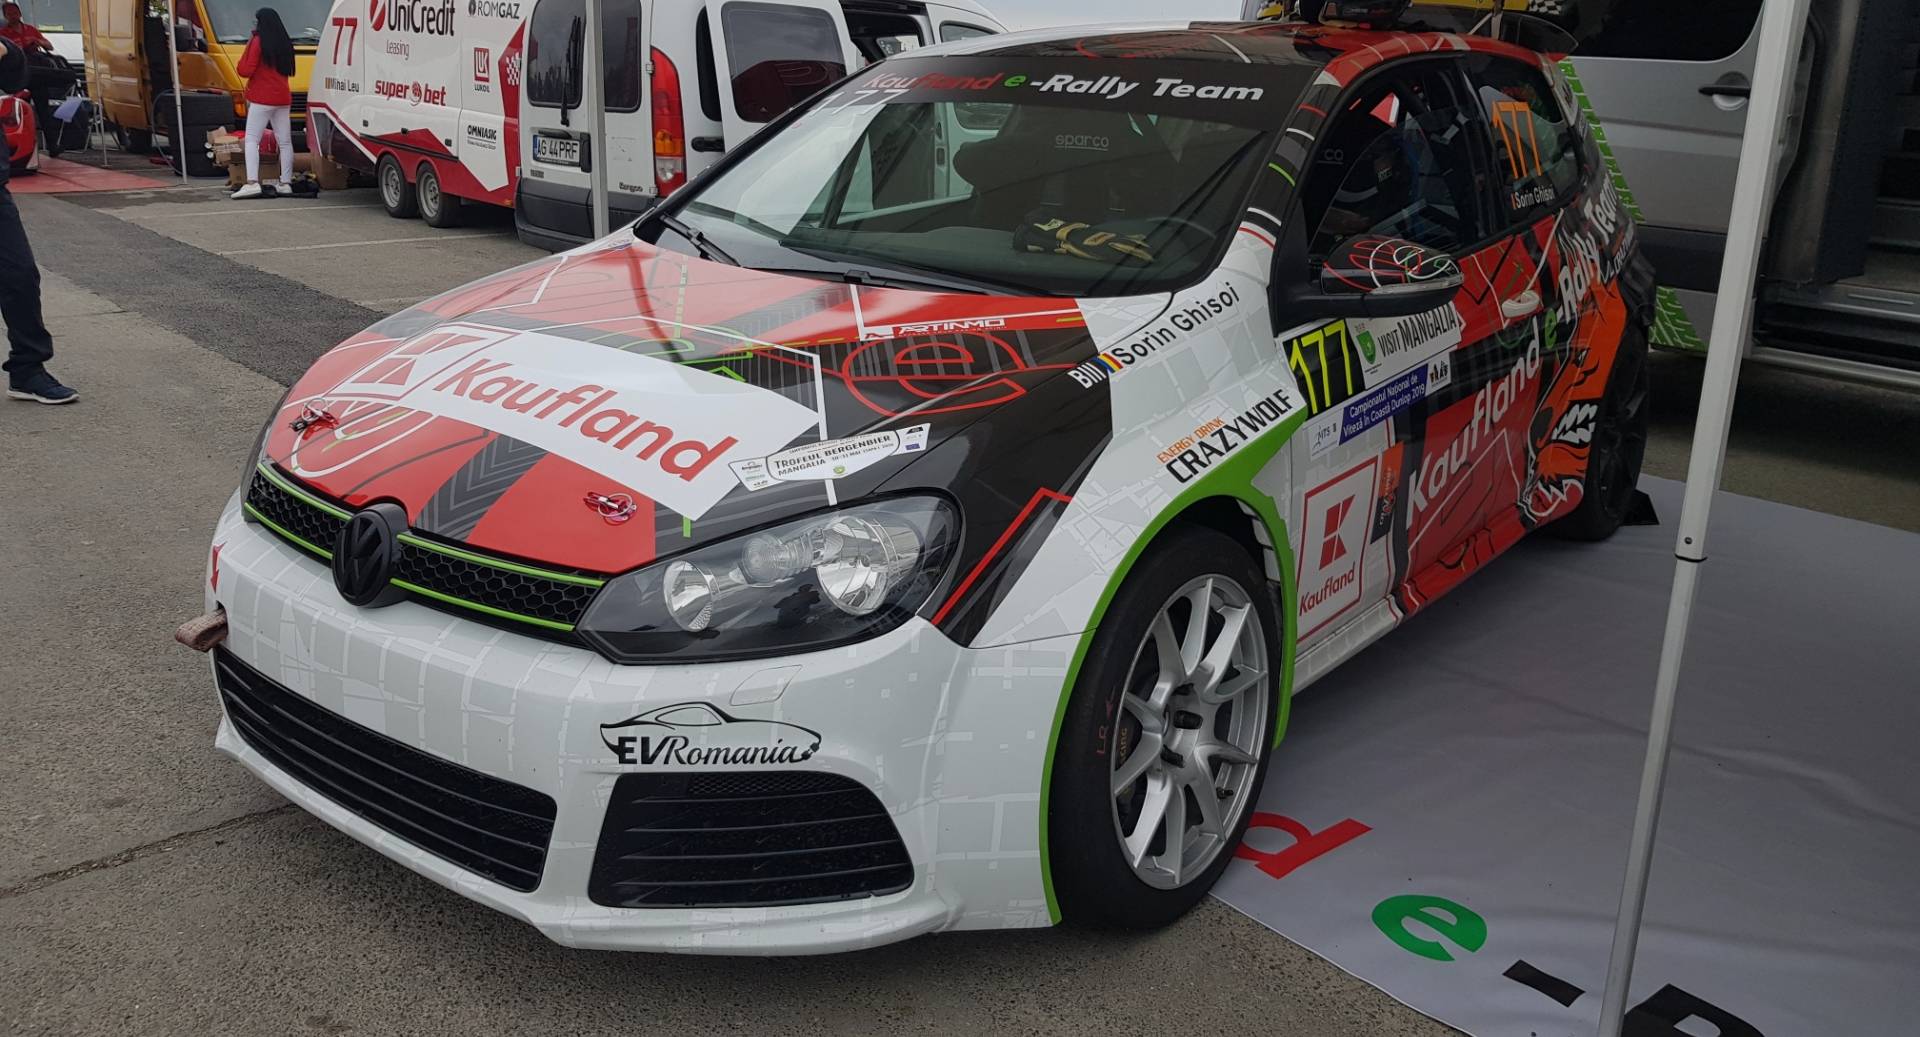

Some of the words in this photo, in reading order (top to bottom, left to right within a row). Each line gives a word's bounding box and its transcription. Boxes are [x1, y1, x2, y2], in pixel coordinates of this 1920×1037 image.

[388, 0, 455, 36] UniCredit
[477, 1, 520, 19] ROMGAZ
[332, 17, 358, 66] 77
[386, 40, 410, 60] Leasing
[347, 82, 360, 93] Leu
[375, 79, 409, 100] super
[424, 83, 447, 106] bet
[474, 84, 490, 93] LUKOIL
[863, 73, 1004, 91] Kaufland
[1152, 78, 1265, 100] Team
[467, 124, 497, 141] OMNIASIG
[548, 139, 558, 157] 44
[559, 141, 578, 160] PRF
[1055, 132, 1110, 152] sparco
[1490, 100, 1543, 180] 177
[1515, 190, 1535, 210] Sorin
[1534, 184, 1556, 205] Ghisoi
[1111, 327, 1177, 366] Sorin
[1169, 282, 1240, 332] Ghisoi
[1377, 328, 1402, 358] VISIT
[1397, 307, 1458, 352] MANGALIA
[1289, 318, 1353, 414] 177
[1406, 317, 1541, 530] Kaufland
[1583, 173, 1619, 246] Team
[1349, 386, 1386, 418] Campionatul
[1410, 374, 1418, 386] de
[1391, 393, 1412, 412] Dunlop
[1411, 383, 1426, 400] 2019
[433, 358, 739, 482] Kaufland
[1165, 388, 1293, 485] CRAZYWOLF
[774, 452, 822, 470] TROFEUL
[824, 434, 891, 458] BERGENBIER
[1156, 430, 1197, 465] ENERGY
[1194, 415, 1228, 440] DRINK
[778, 457, 827, 477] MANGALIA
[1299, 562, 1356, 616] Kaufland
